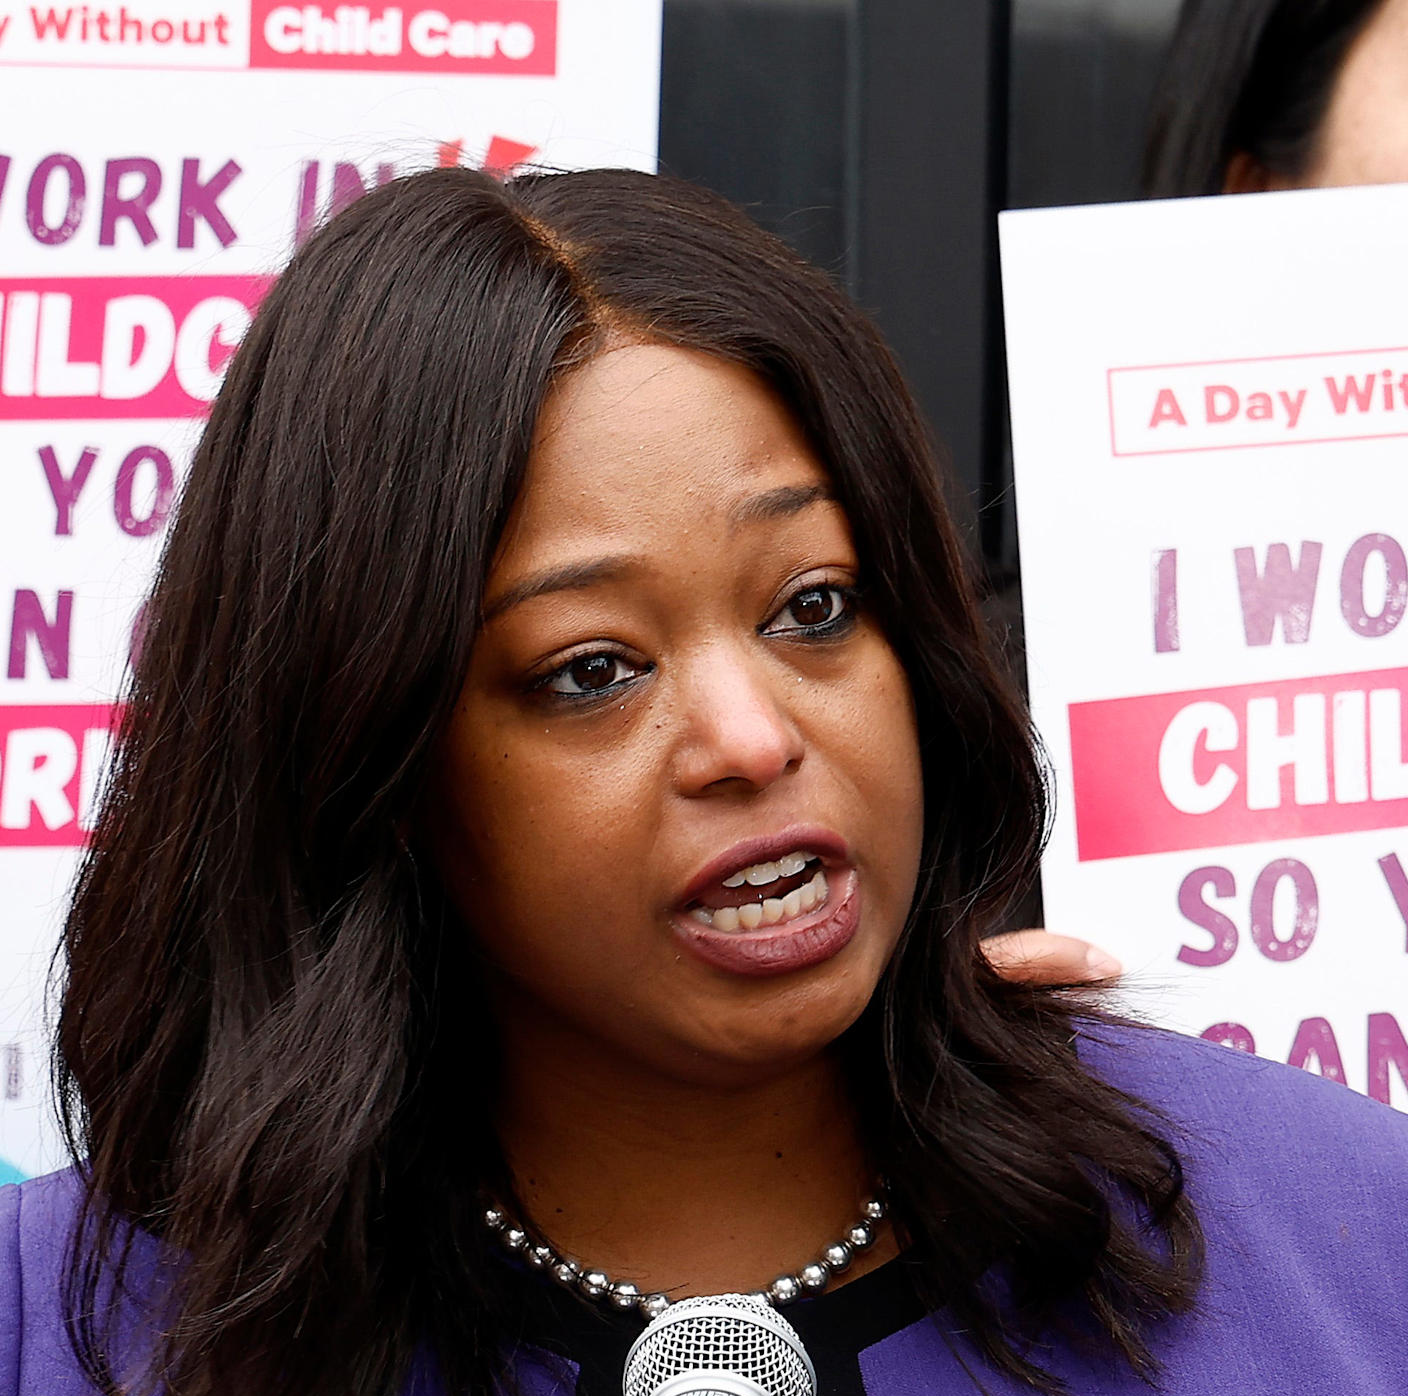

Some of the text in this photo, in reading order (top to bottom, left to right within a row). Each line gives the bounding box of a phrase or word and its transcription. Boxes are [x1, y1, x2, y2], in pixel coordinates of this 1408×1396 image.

[29, 5, 229, 47] Without
[265, 6, 403, 58] Child
[409, 12, 535, 61] Care
[1148, 388, 1188, 428] A
[1204, 384, 1308, 429] Day
[38, 444, 176, 539] YO
[1153, 548, 1181, 654] I
[1175, 857, 1320, 969] SO
